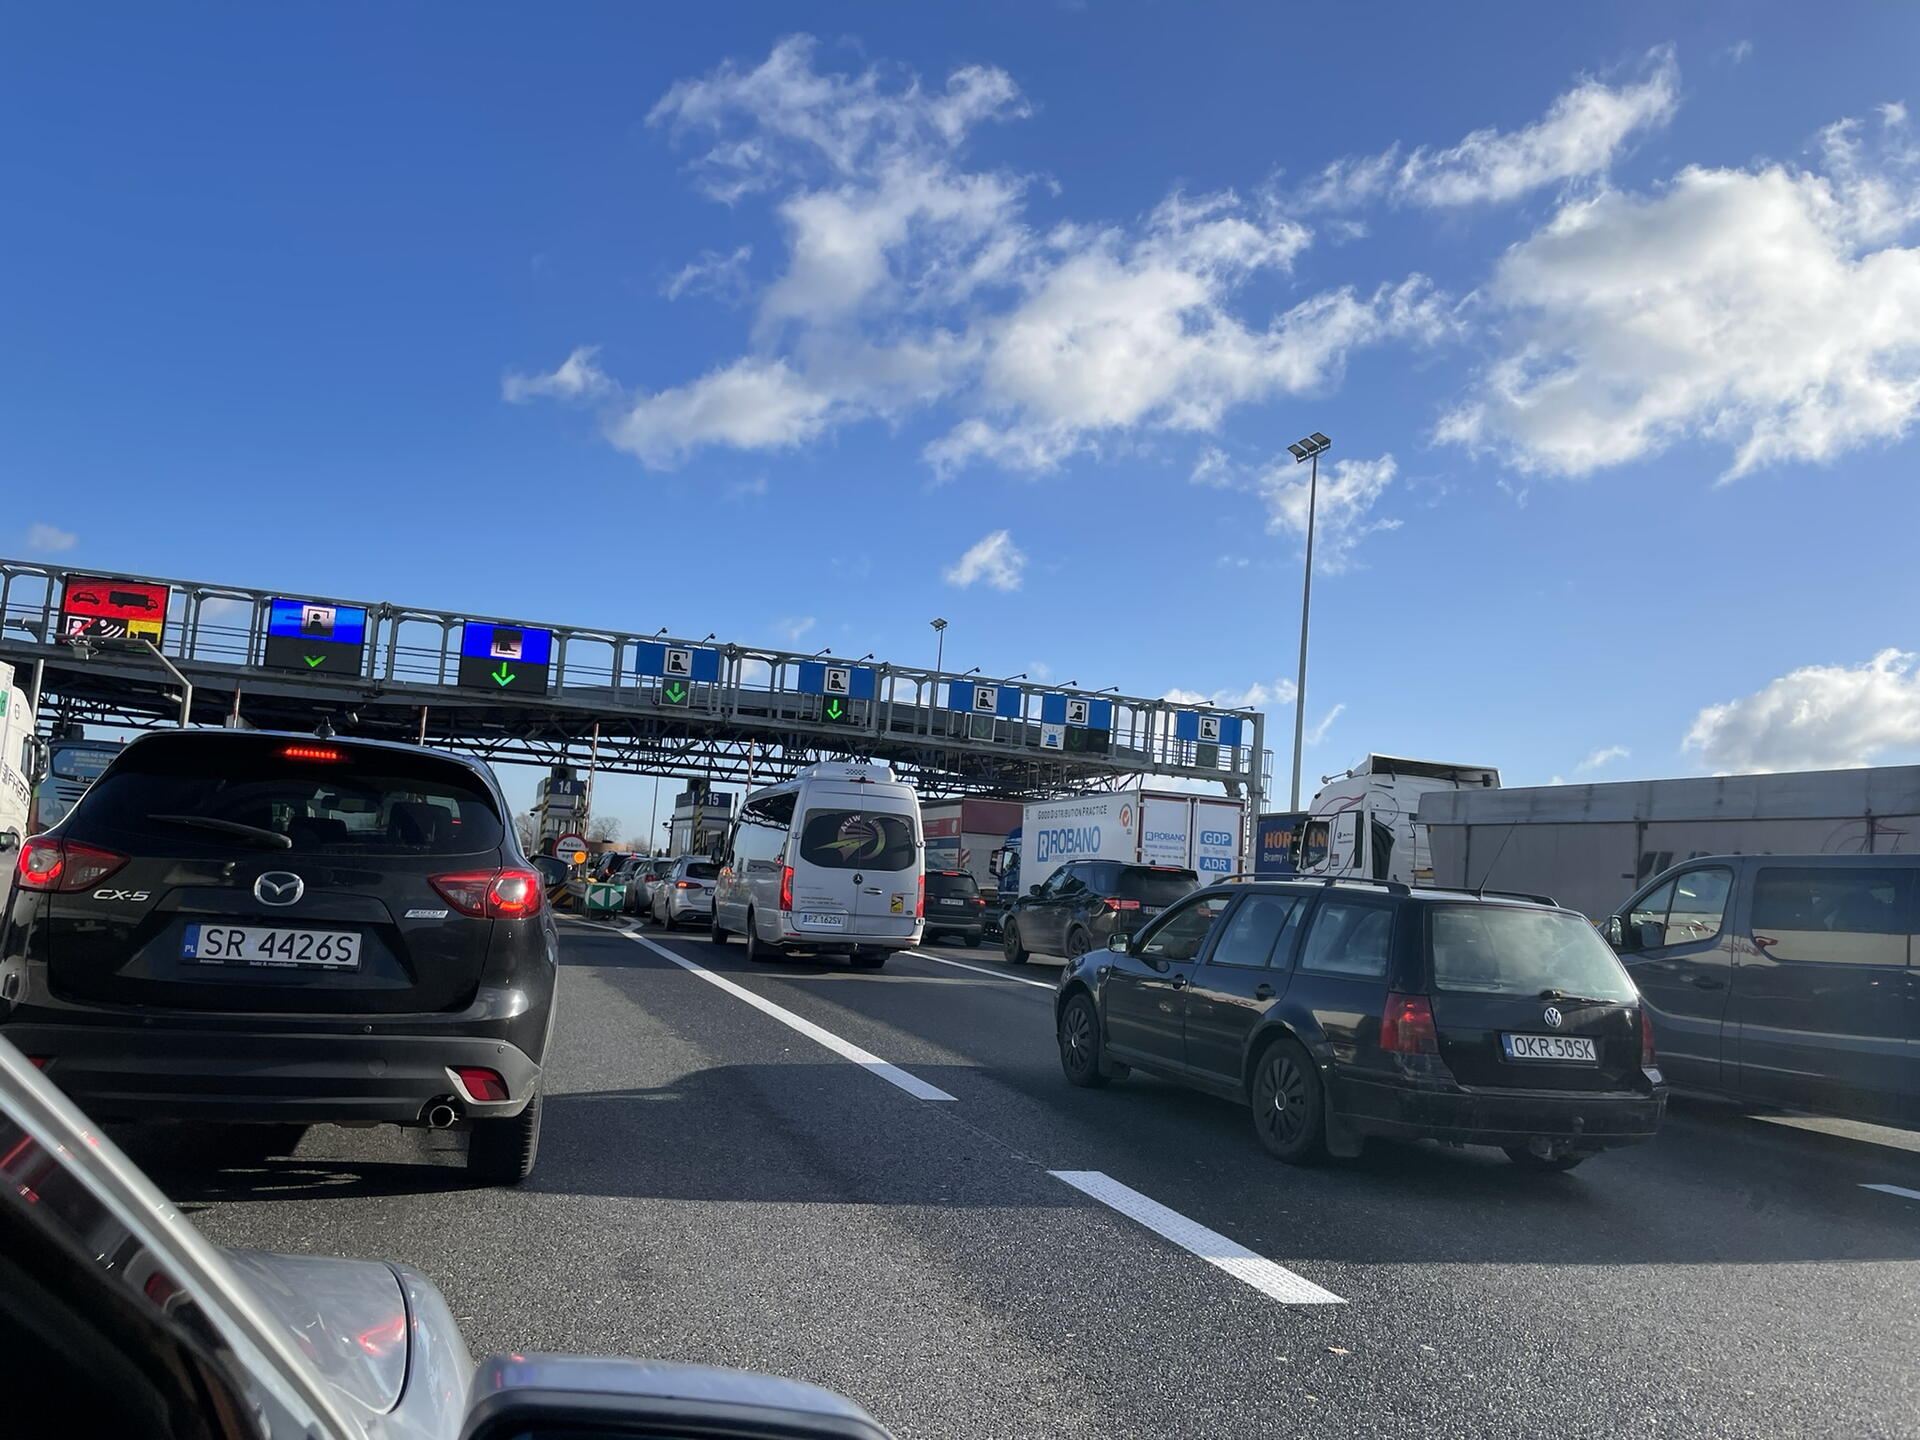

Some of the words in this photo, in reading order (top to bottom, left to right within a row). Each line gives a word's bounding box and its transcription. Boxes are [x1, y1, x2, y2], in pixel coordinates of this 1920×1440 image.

[558, 780, 571, 794] 14
[707, 793, 720, 806] 15
[1050, 825, 1101, 854] ROBANO
[1154, 832, 1186, 842] ROBANO
[1203, 831, 1230, 846] GDP
[1203, 857, 1227, 871] ADR
[93, 889, 152, 901] CX-5
[184, 944, 196, 953] PL
[204, 928, 246, 957] SR
[258, 931, 354, 962] 4426S
[1514, 1037, 1553, 1057] OKR
[1554, 1038, 1595, 1059] 50SK
